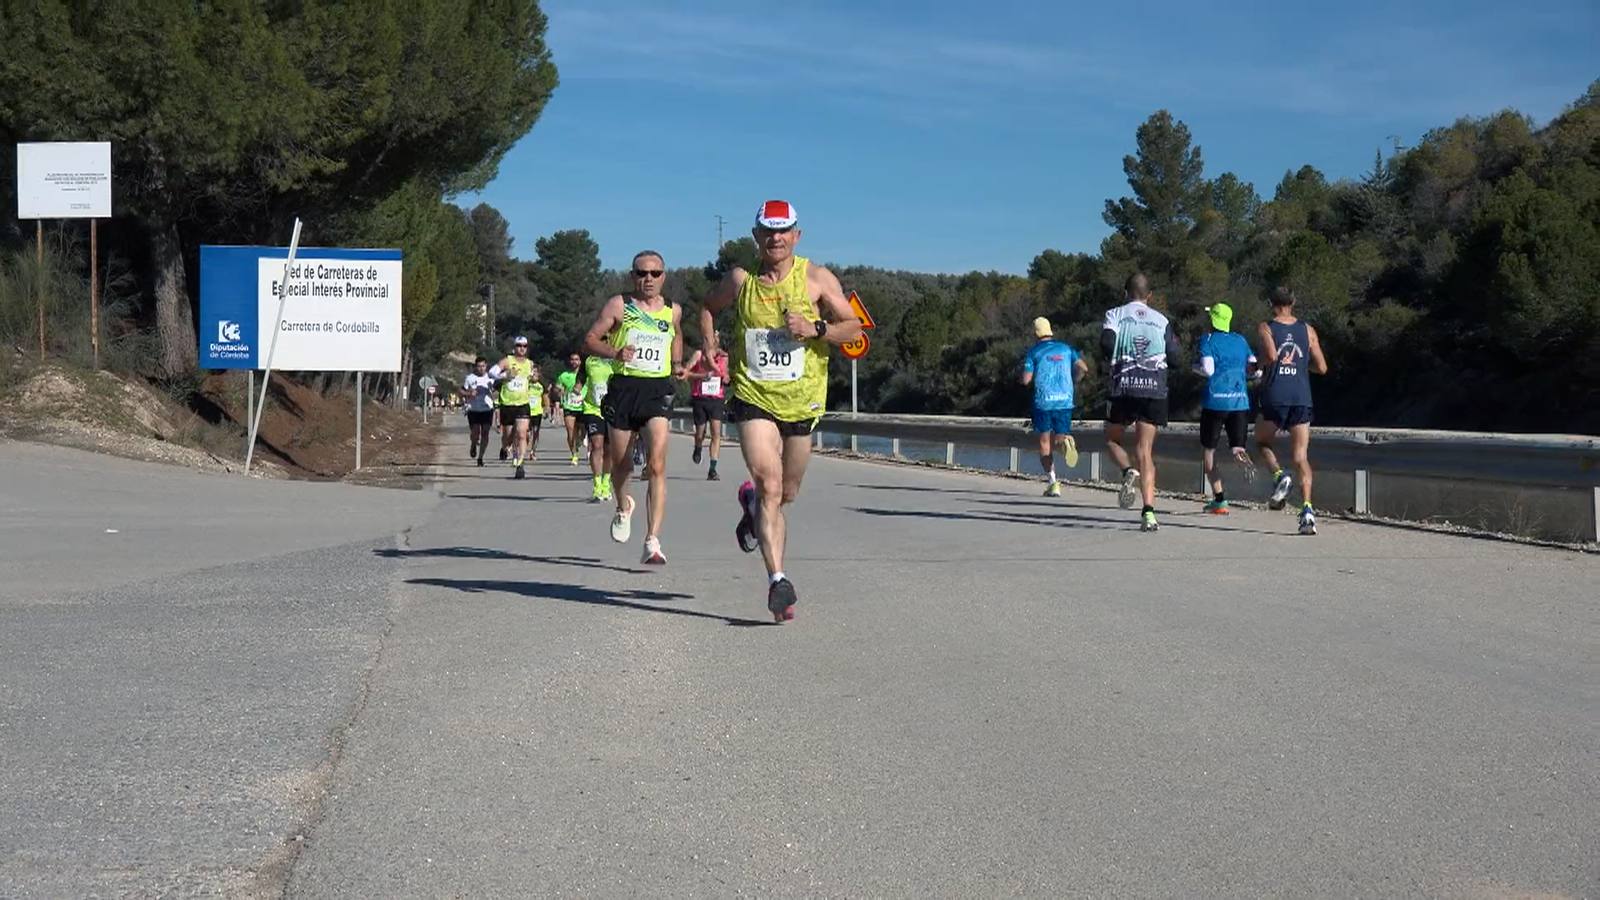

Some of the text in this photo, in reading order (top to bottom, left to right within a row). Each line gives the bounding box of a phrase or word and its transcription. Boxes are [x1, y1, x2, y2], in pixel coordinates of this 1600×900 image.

[283, 263, 378, 281] ed de Carreteras de
[312, 281, 343, 297] Interés
[345, 282, 389, 298] Provincial
[280, 320, 380, 333] Carretera de Cordobilla
[209, 343, 249, 352] Diputación
[636, 347, 660, 361] 101
[209, 351, 219, 359] de
[758, 351, 792, 367] 340
[1279, 366, 1298, 376] EDU
